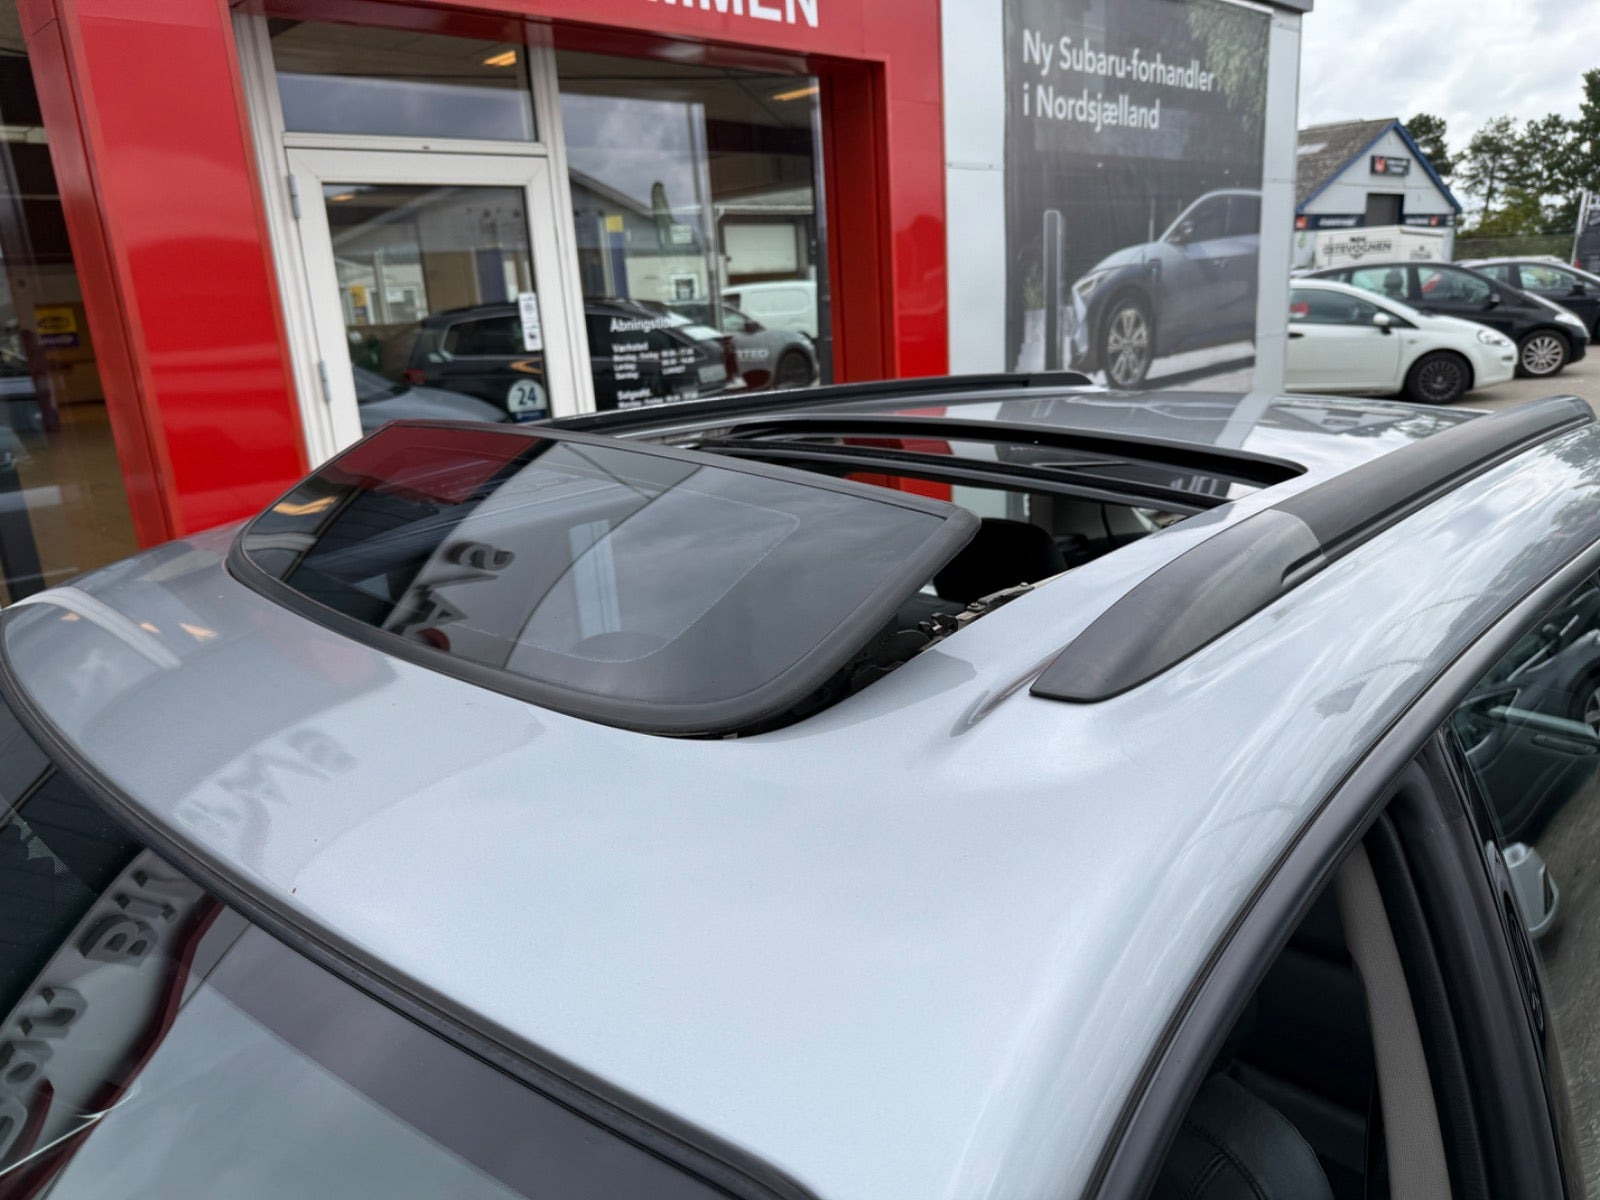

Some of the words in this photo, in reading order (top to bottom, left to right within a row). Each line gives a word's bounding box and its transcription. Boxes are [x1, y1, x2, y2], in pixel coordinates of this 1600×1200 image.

[1022, 29, 1054, 77] Ny
[1059, 36, 1215, 92] Subaru-forhandler
[1023, 83, 1031, 117] i
[1036, 84, 1161, 133] Nordsjælland
[517, 387, 537, 406] 24
